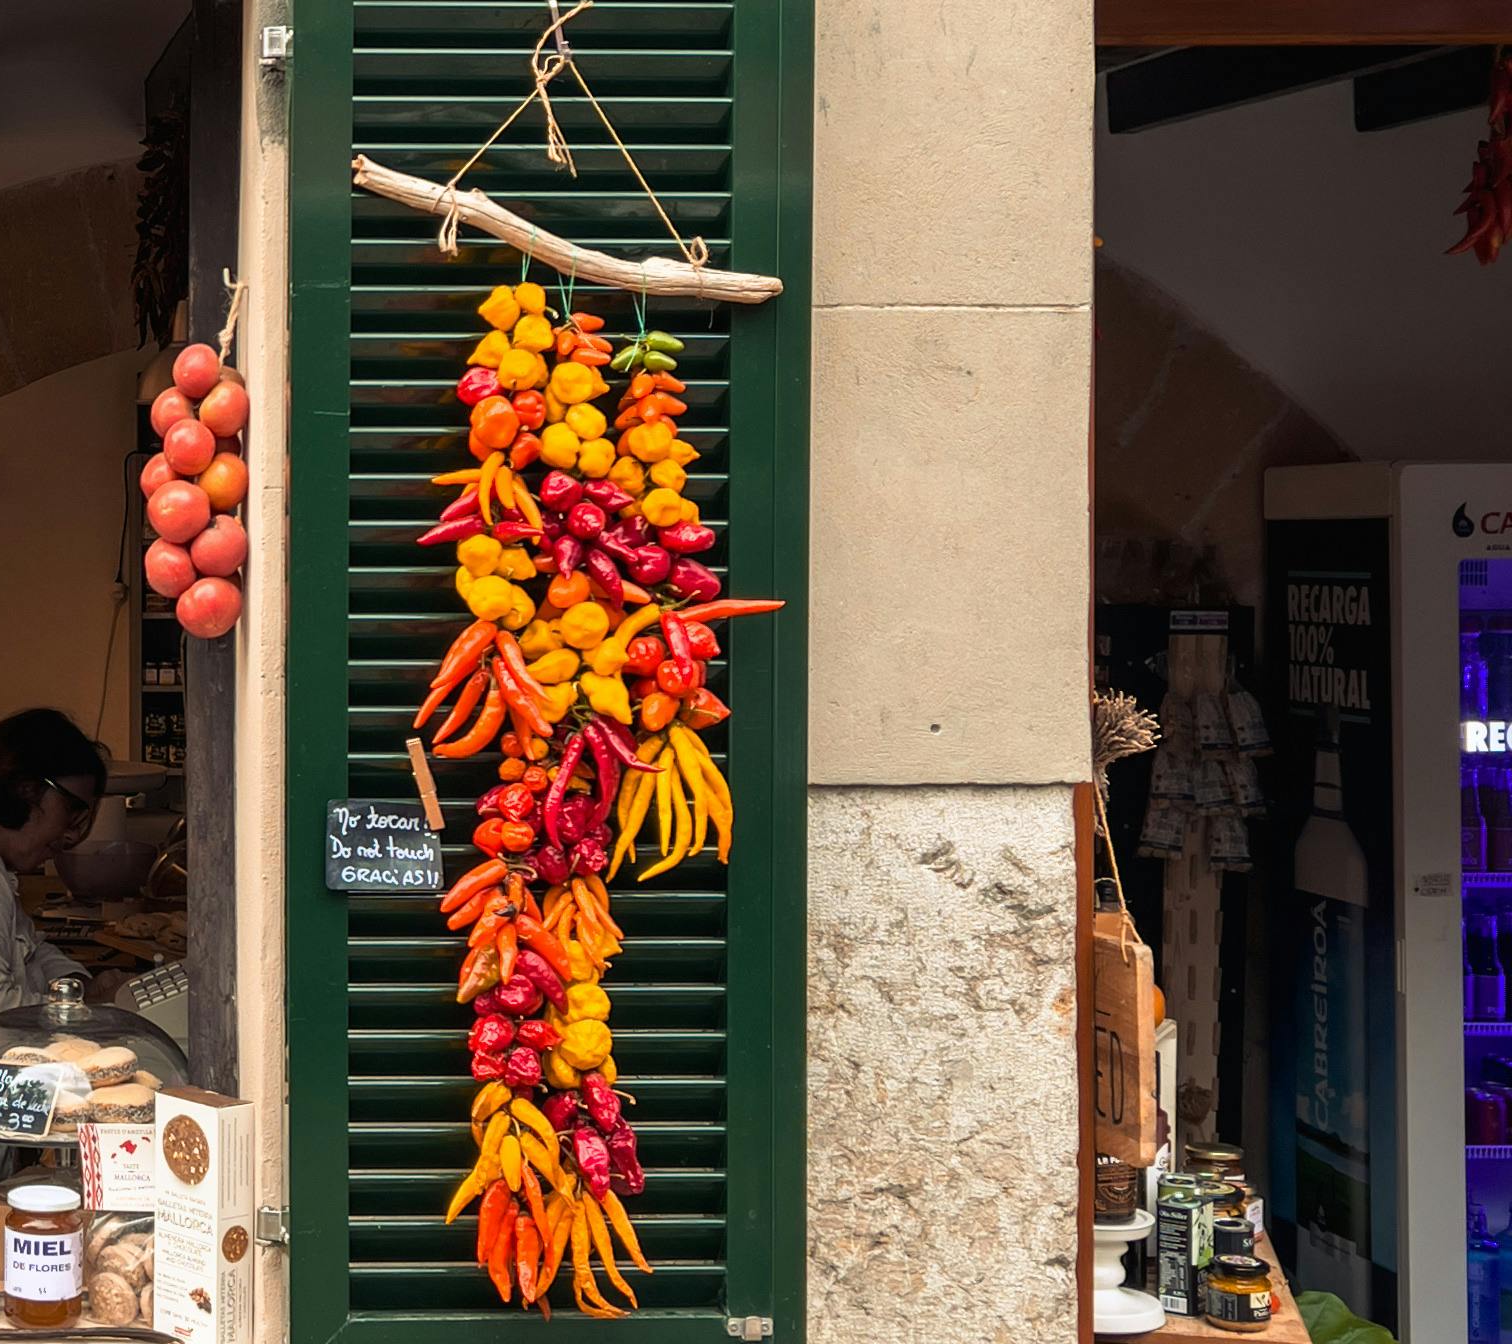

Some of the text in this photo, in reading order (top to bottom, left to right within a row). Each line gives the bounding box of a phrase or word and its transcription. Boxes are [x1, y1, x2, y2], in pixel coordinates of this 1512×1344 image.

[1287, 584, 1372, 626] RECARGA
[1288, 623, 1334, 665] 100%
[1288, 665, 1372, 710] NATURAL
[333, 807, 361, 836] No
[329, 835, 434, 862] Do not touch
[12, 1093, 27, 1109] de
[114, 1174, 151, 1182] MALLORCA
[156, 1211, 214, 1236] MALLORCA
[13, 1237, 72, 1257] MIEL
[12, 1260, 72, 1273] DE FLORES
[226, 1268, 237, 1344] MALLORCA
